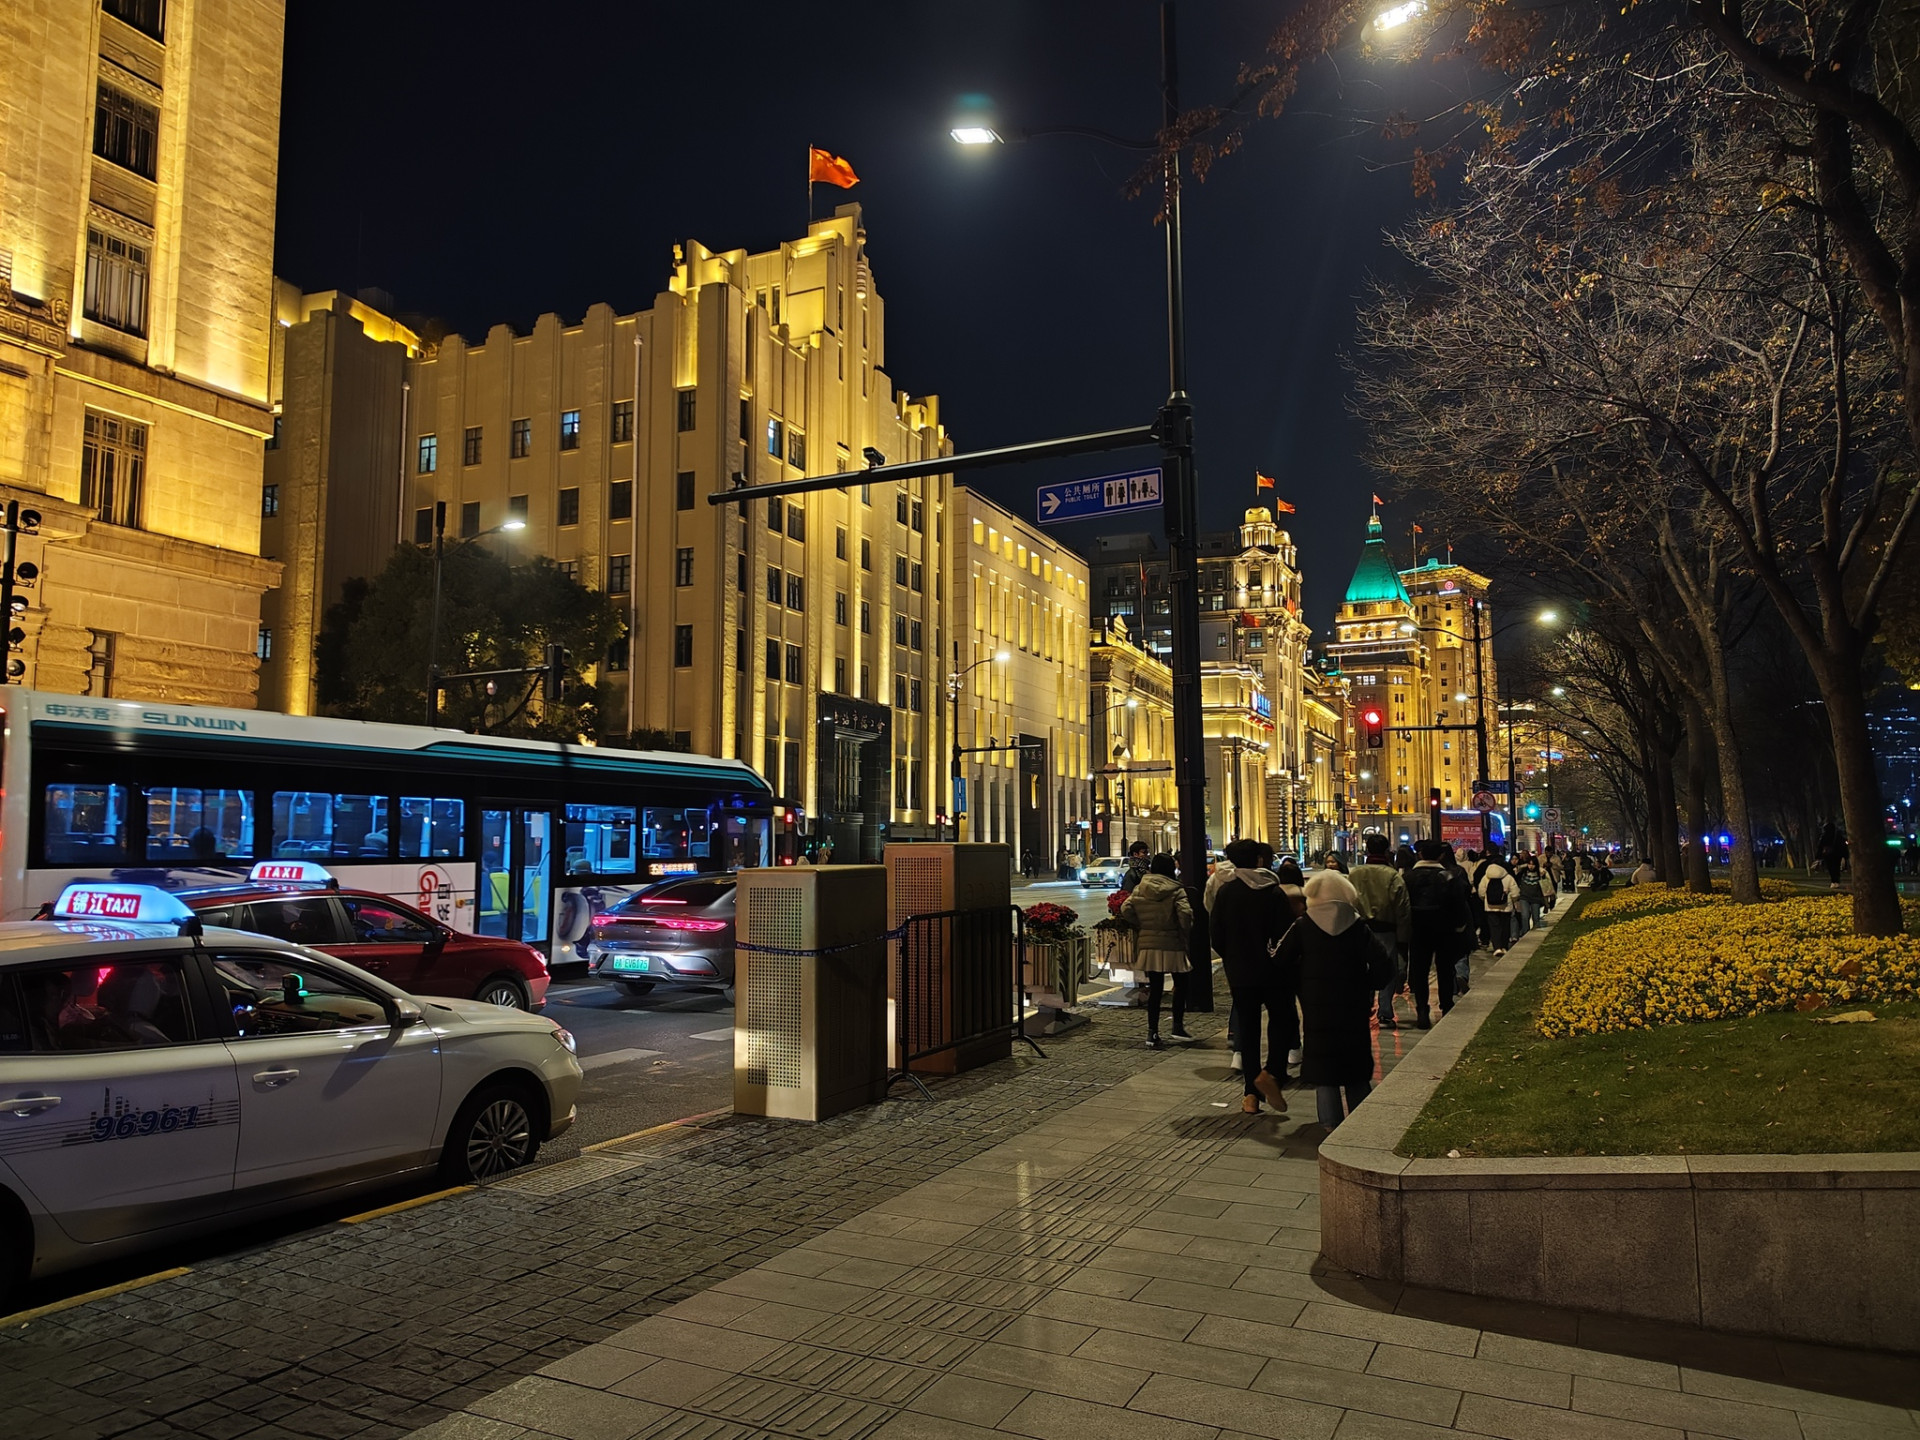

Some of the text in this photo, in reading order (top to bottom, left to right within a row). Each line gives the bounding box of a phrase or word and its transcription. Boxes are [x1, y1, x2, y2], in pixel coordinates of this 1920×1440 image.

[1064, 482, 1100, 497] 公共厕所
[46, 703, 135, 721] 申沃客
[142, 711, 247, 732] SUNWIN
[264, 867, 298, 878] TAXI
[72, 892, 136, 915] 锦江 TAXI
[92, 1105, 199, 1142] 96961
